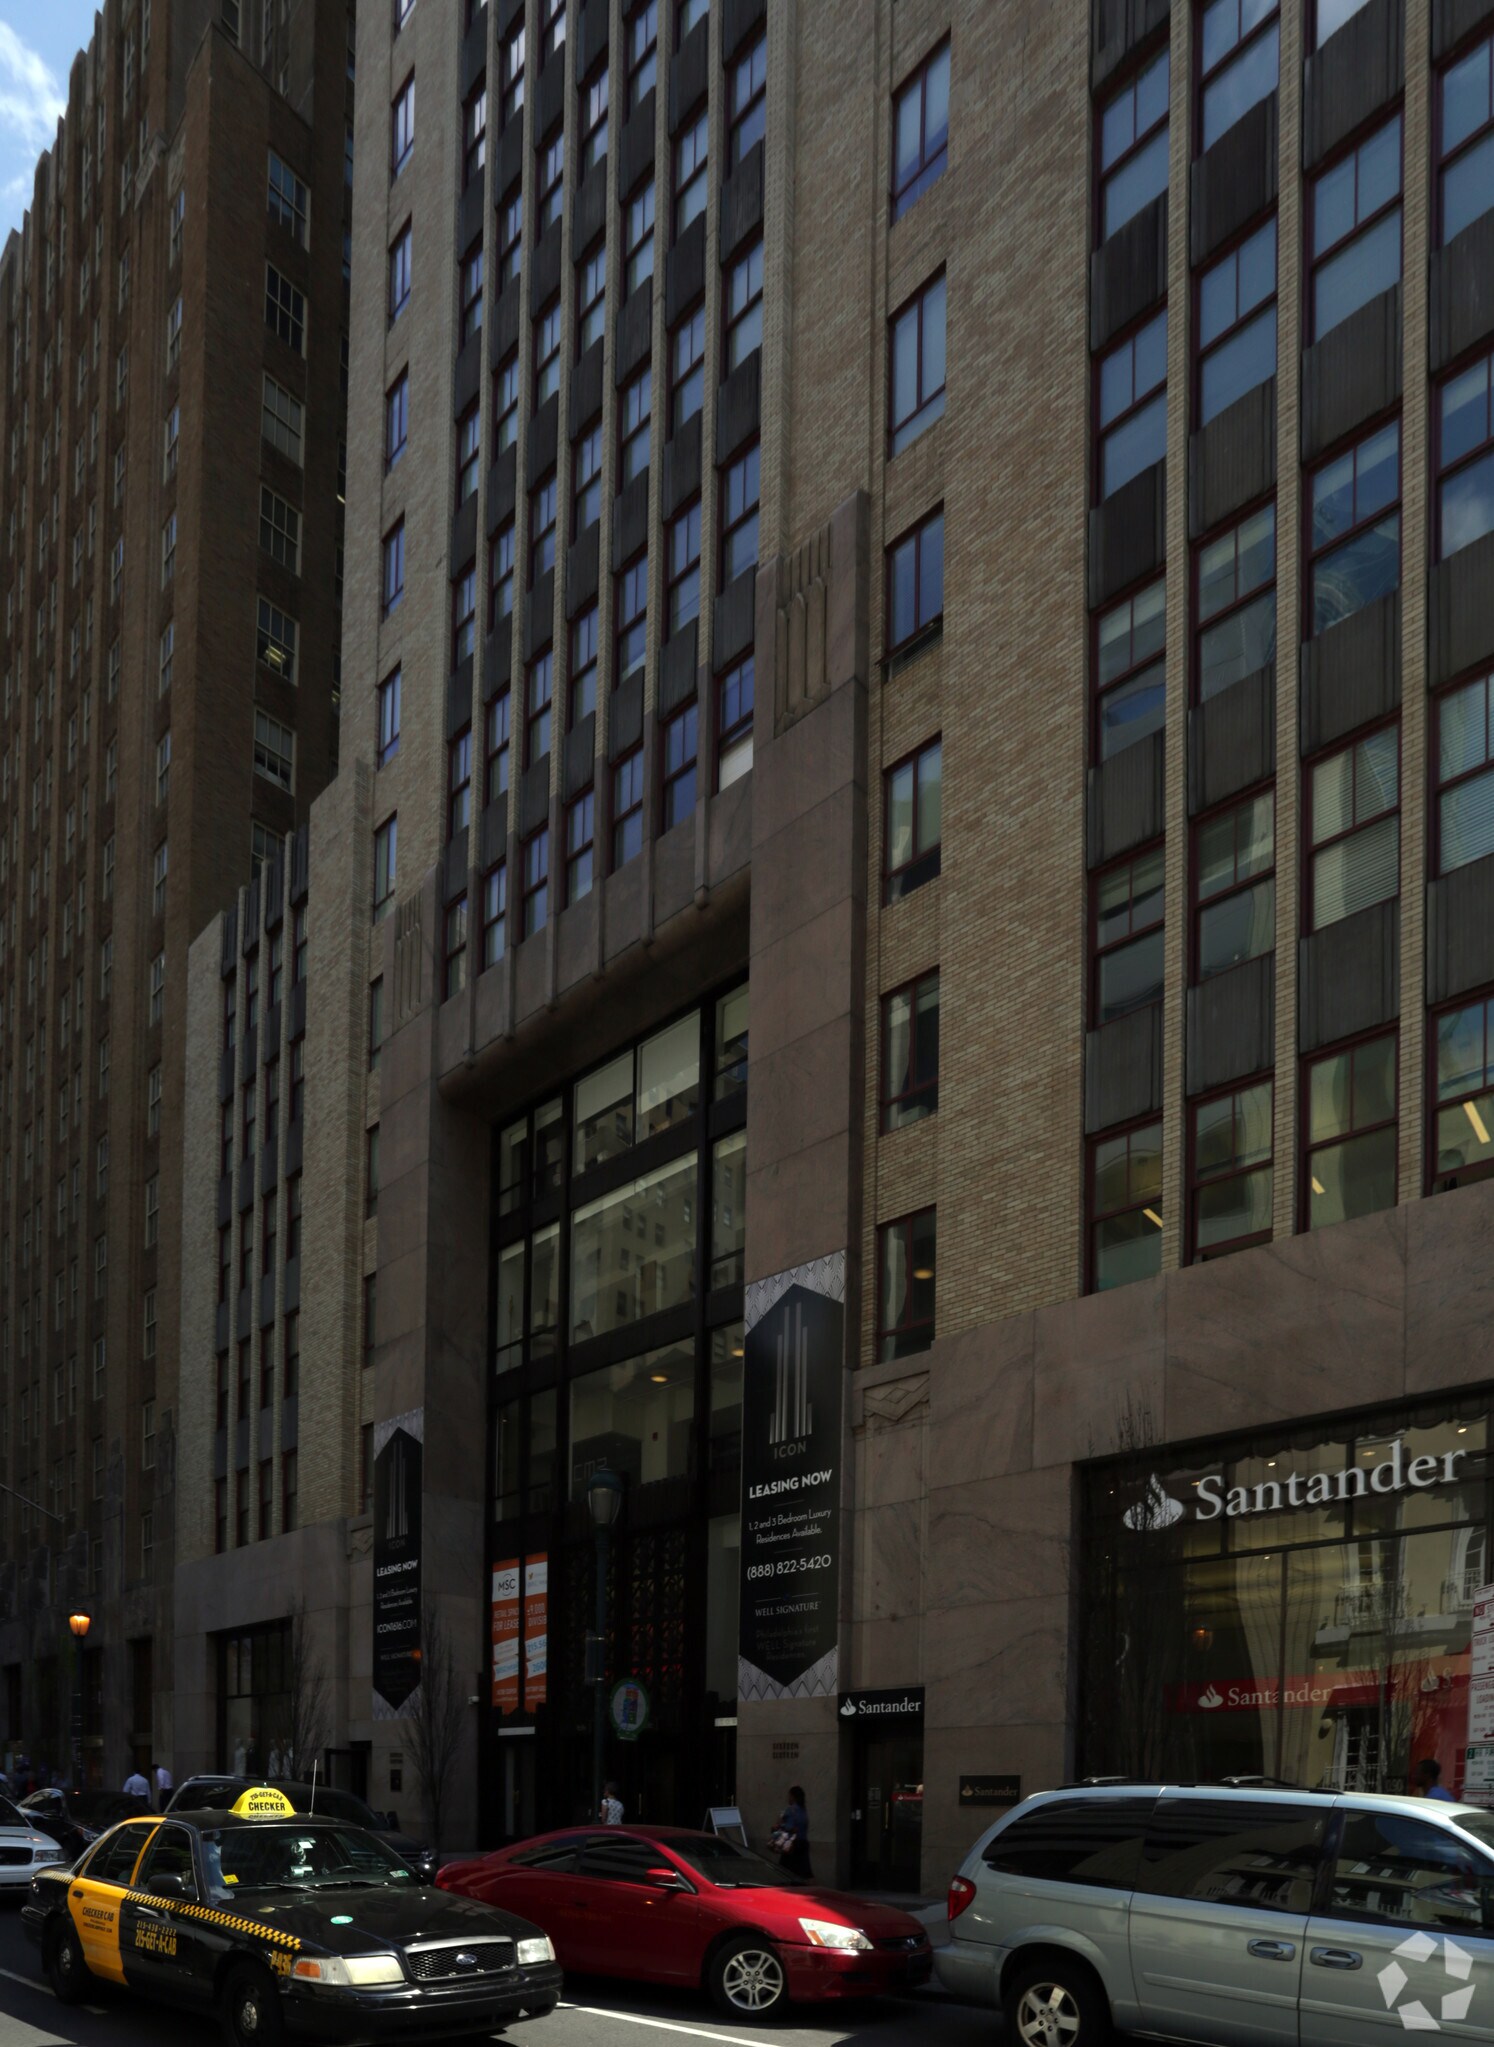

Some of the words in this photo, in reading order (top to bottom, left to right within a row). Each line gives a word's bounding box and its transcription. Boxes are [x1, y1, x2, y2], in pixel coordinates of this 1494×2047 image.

[774, 1441, 807, 1460] ICON
[749, 1477, 799, 1499] LEASING
[801, 1469, 833, 1488] NOW
[1195, 1439, 1466, 1520] Santander
[759, 1516, 771, 1529] and
[772, 1517, 777, 1527] 3
[777, 1512, 808, 1525] Bedroom
[808, 1508, 832, 1519] Luxury
[756, 1531, 790, 1544] Residences
[376, 1563, 402, 1577] LEASING
[402, 1559, 418, 1571] NOW
[747, 1562, 775, 1581] (888)
[776, 1554, 832, 1575] 822-5420
[497, 1578, 516, 1592] MSC
[754, 1606, 775, 1617] WELL
[776, 1601, 819, 1615] SIGNATURE
[1228, 1682, 1333, 1707] Santander
[858, 1697, 921, 1714] Santander
[974, 1786, 1018, 1797] Santander
[248, 1801, 286, 1811] CHECKER
[82, 1906, 104, 1919] CHECKER
[104, 1911, 115, 1922] CAB
[135, 1929, 177, 1956] 215-GET-A-CAB
